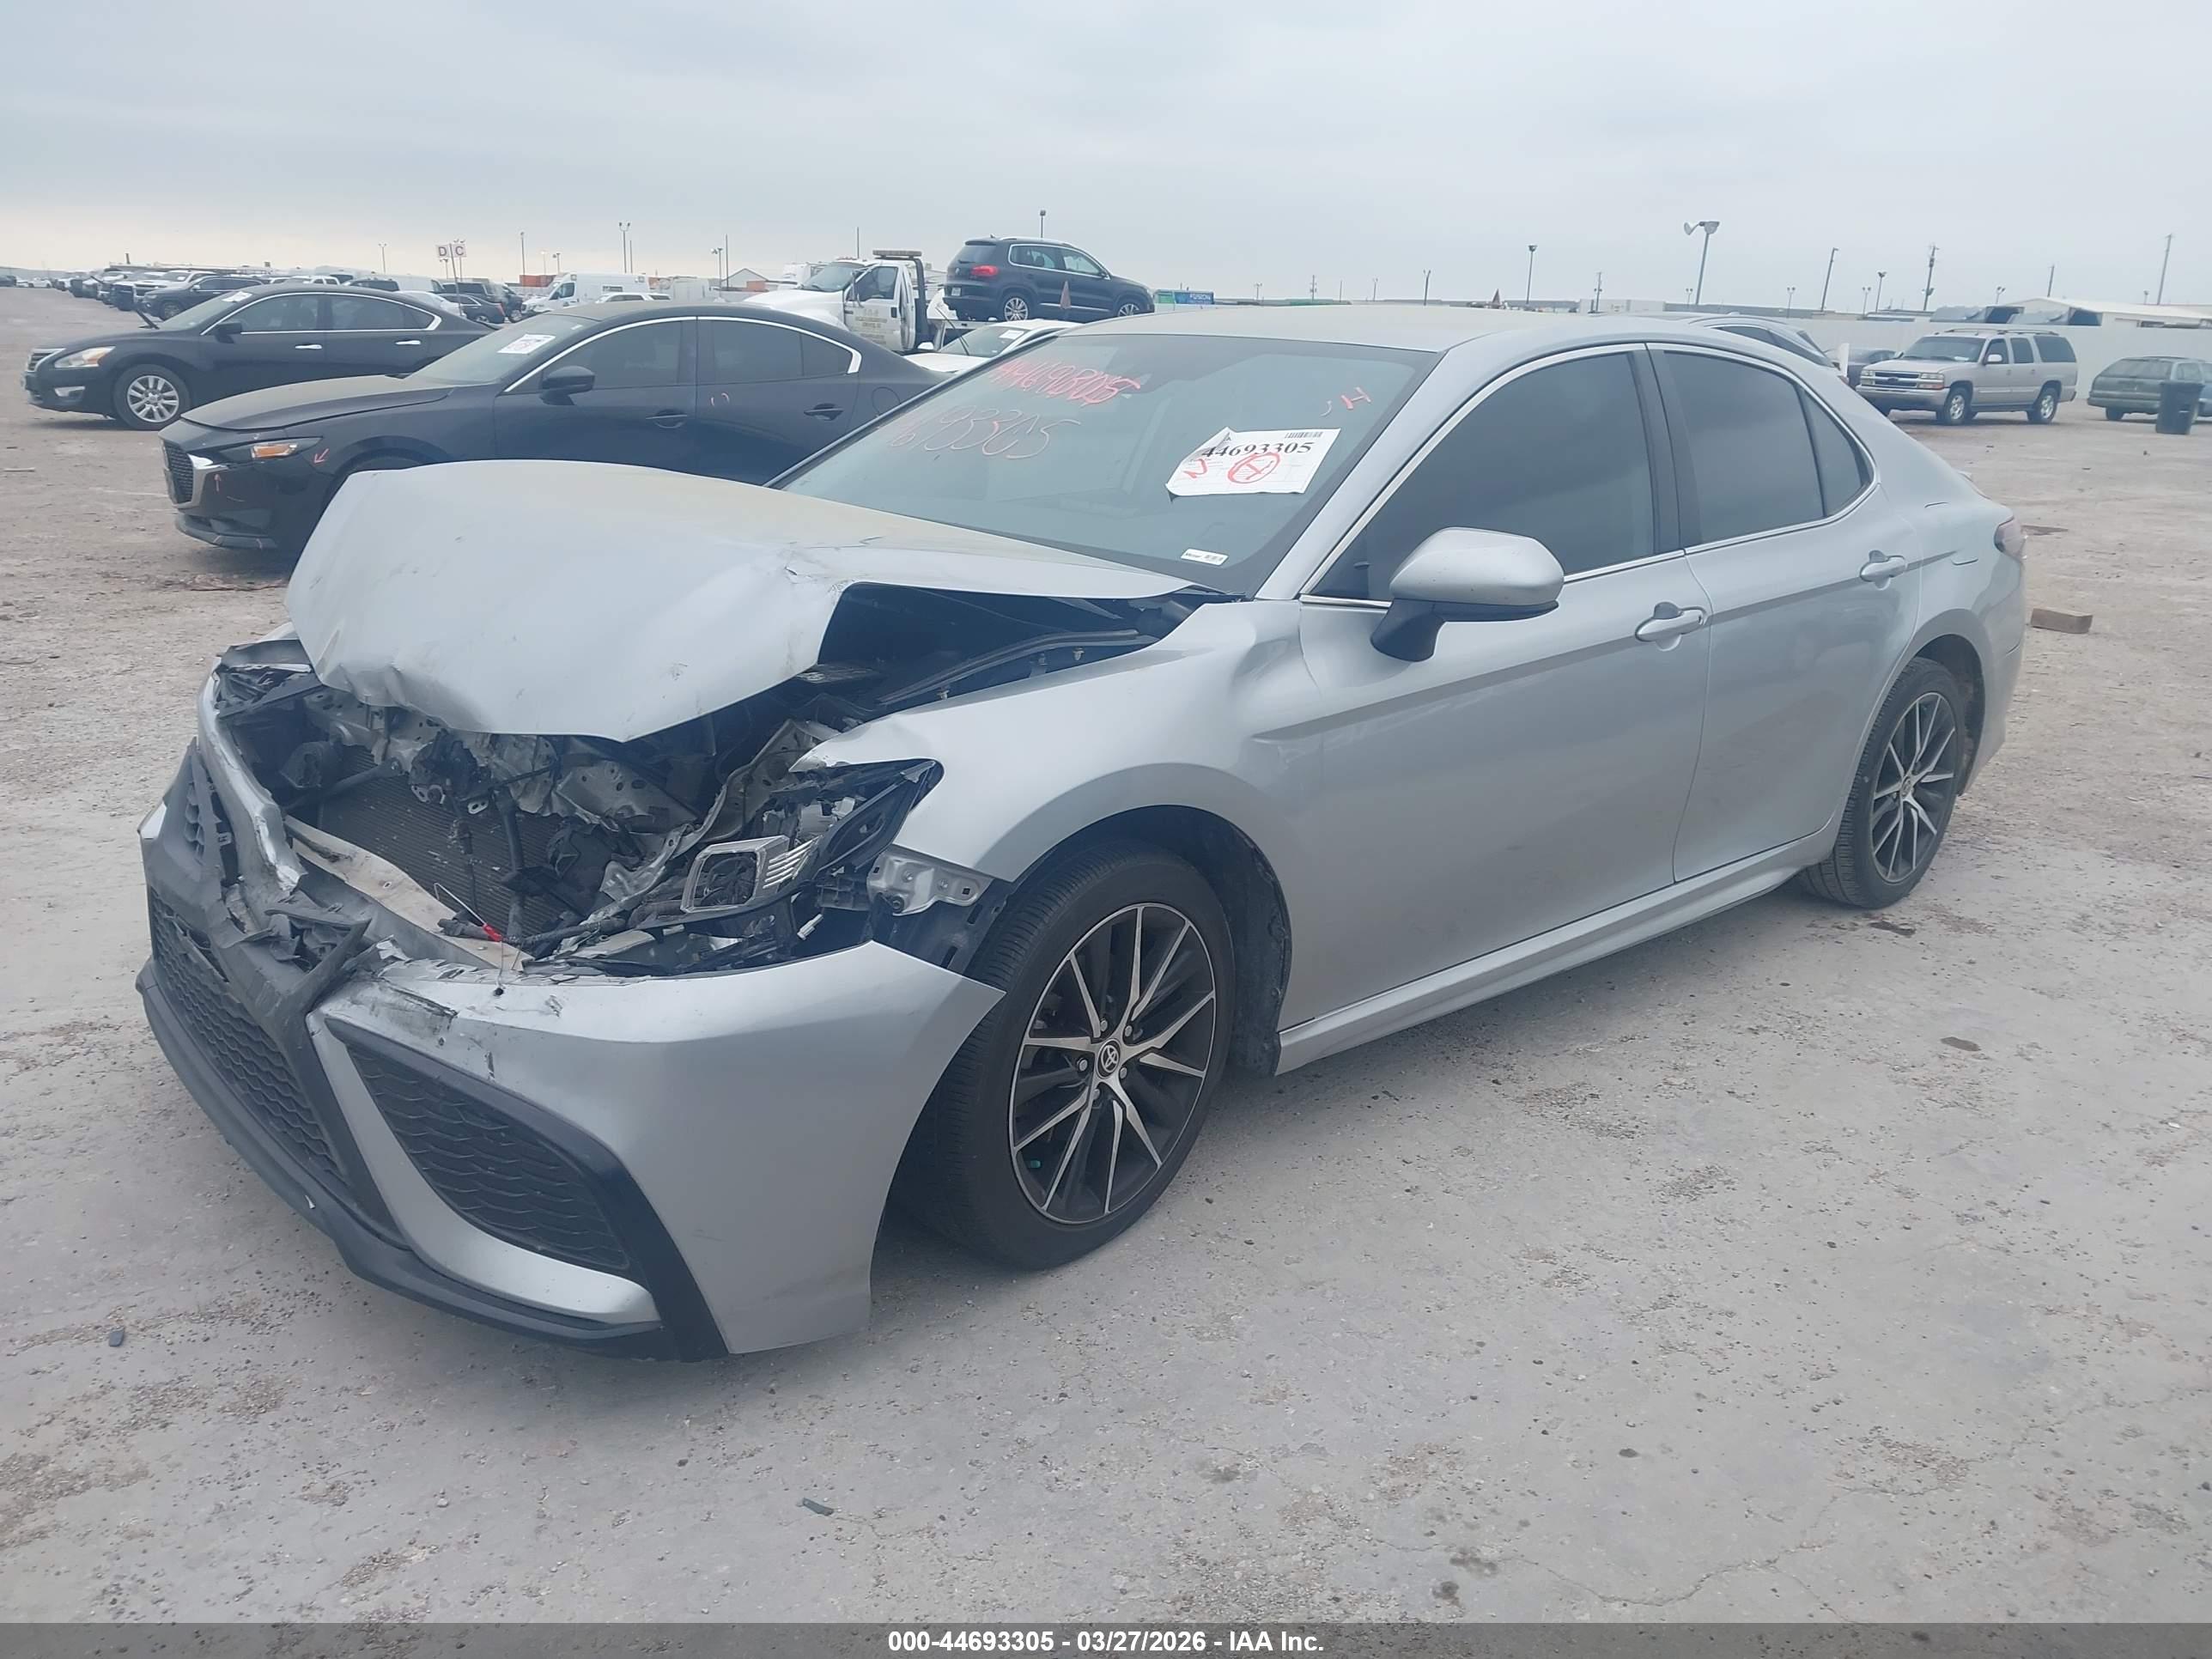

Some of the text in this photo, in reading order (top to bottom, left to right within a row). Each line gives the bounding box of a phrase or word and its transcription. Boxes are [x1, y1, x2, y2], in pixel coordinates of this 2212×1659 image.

[438, 246, 447, 256] D
[455, 246, 465, 256] C
[1202, 441, 1316, 458] 44693305
